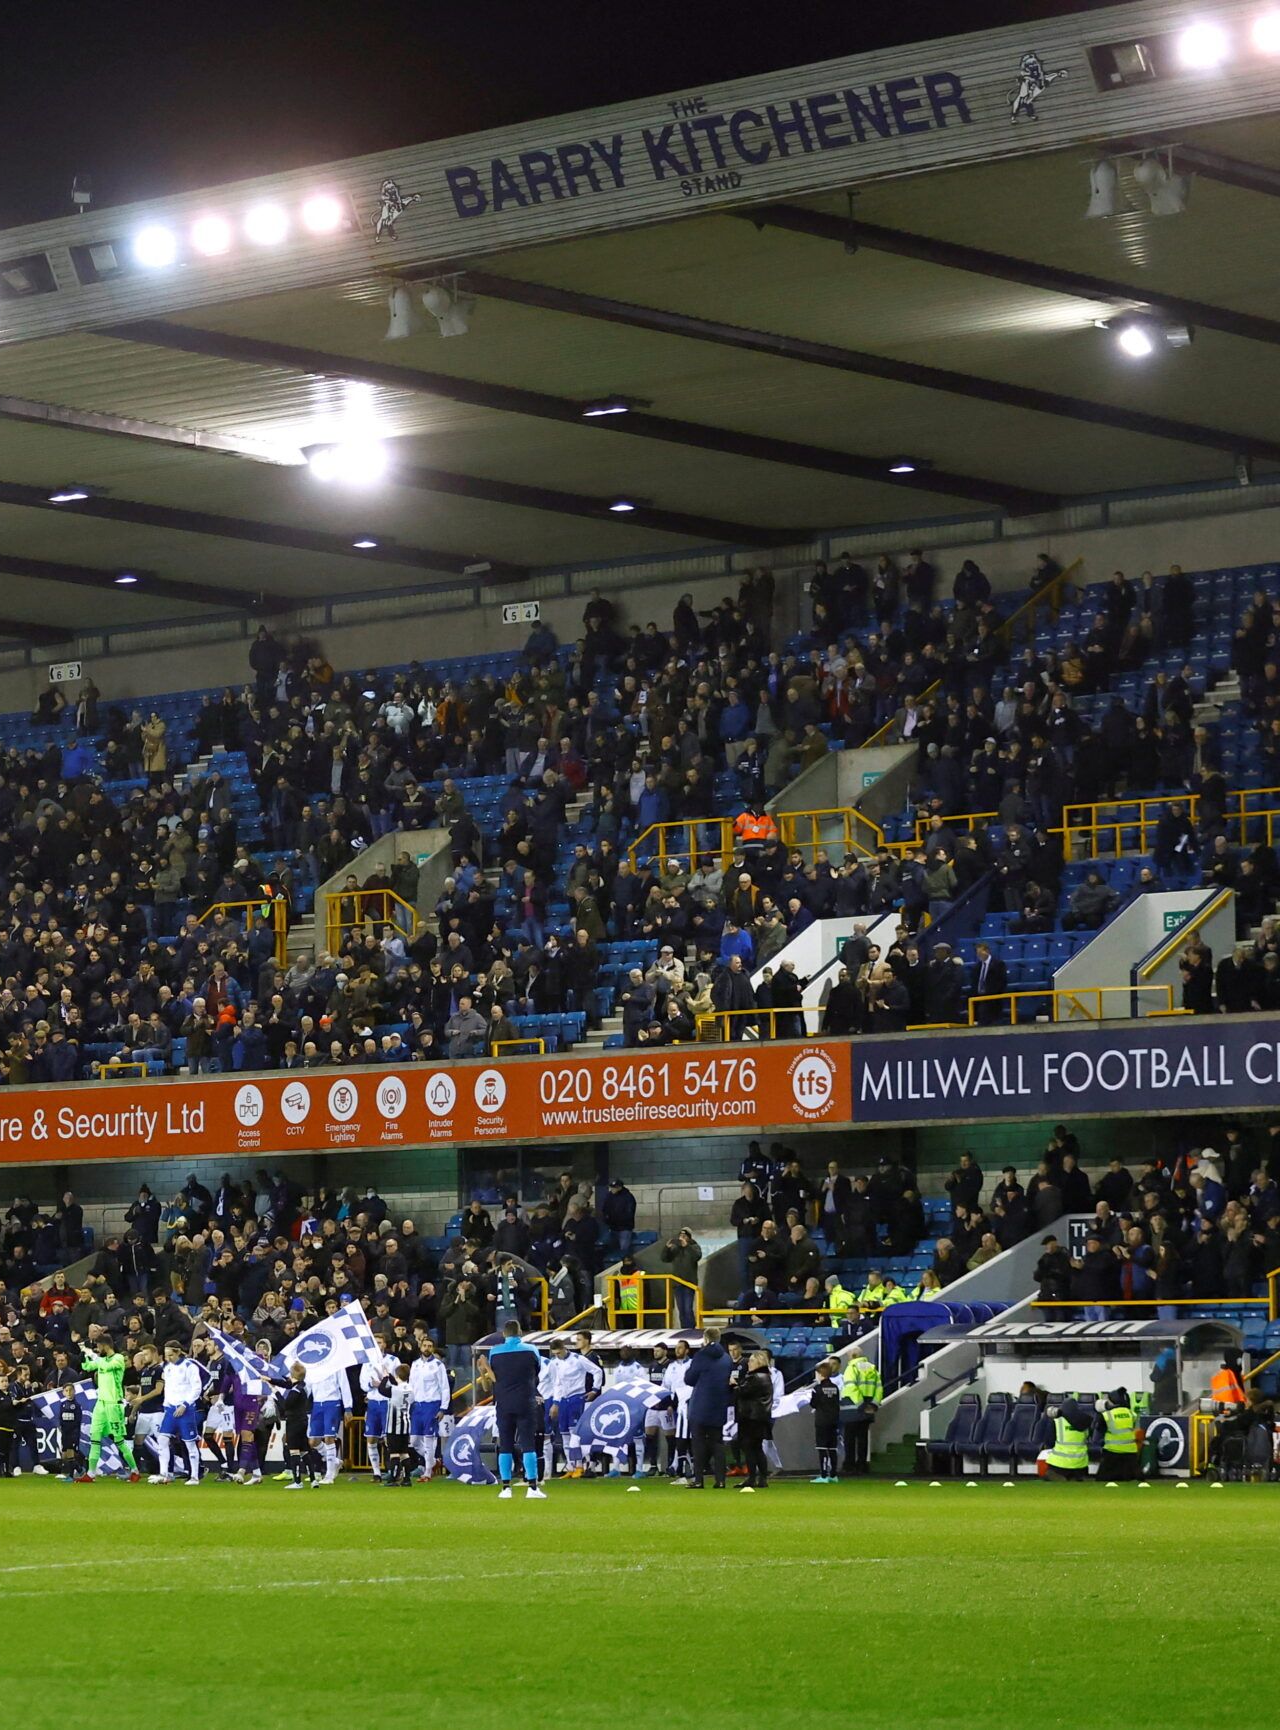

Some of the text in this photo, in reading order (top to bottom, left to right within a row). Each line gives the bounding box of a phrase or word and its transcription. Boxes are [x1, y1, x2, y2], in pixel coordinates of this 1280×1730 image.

[666, 96, 709, 118] THE
[445, 71, 973, 219] BARRY KITCHENER
[680, 170, 743, 198] STAND
[512, 610, 531, 622] 5 4
[56, 670, 75, 680] 6 5
[860, 1055, 1031, 1102] MILLWALL
[1043, 1045, 1234, 1094] FOOTBALL
[540, 1057, 757, 1105] 020 8461 5476
[797, 1070, 828, 1096] tfs
[542, 1098, 757, 1126] www.trusteefiresecurity.com
[31, 1109, 49, 1141] &
[56, 1101, 158, 1144] Security
[166, 1101, 205, 1135] Ltd
[385, 1121, 399, 1131] Fire
[428, 1119, 453, 1129] Intruder
[477, 1115, 504, 1127] Security
[237, 1129, 261, 1138] Access
[286, 1126, 305, 1136] CCTV
[325, 1122, 361, 1134] Emergency
[430, 1128, 453, 1138] Alarms
[474, 1124, 508, 1136] Personnel
[330, 1131, 356, 1143] Lighting
[380, 1130, 404, 1141] Alarms
[237, 1137, 261, 1148] Control
